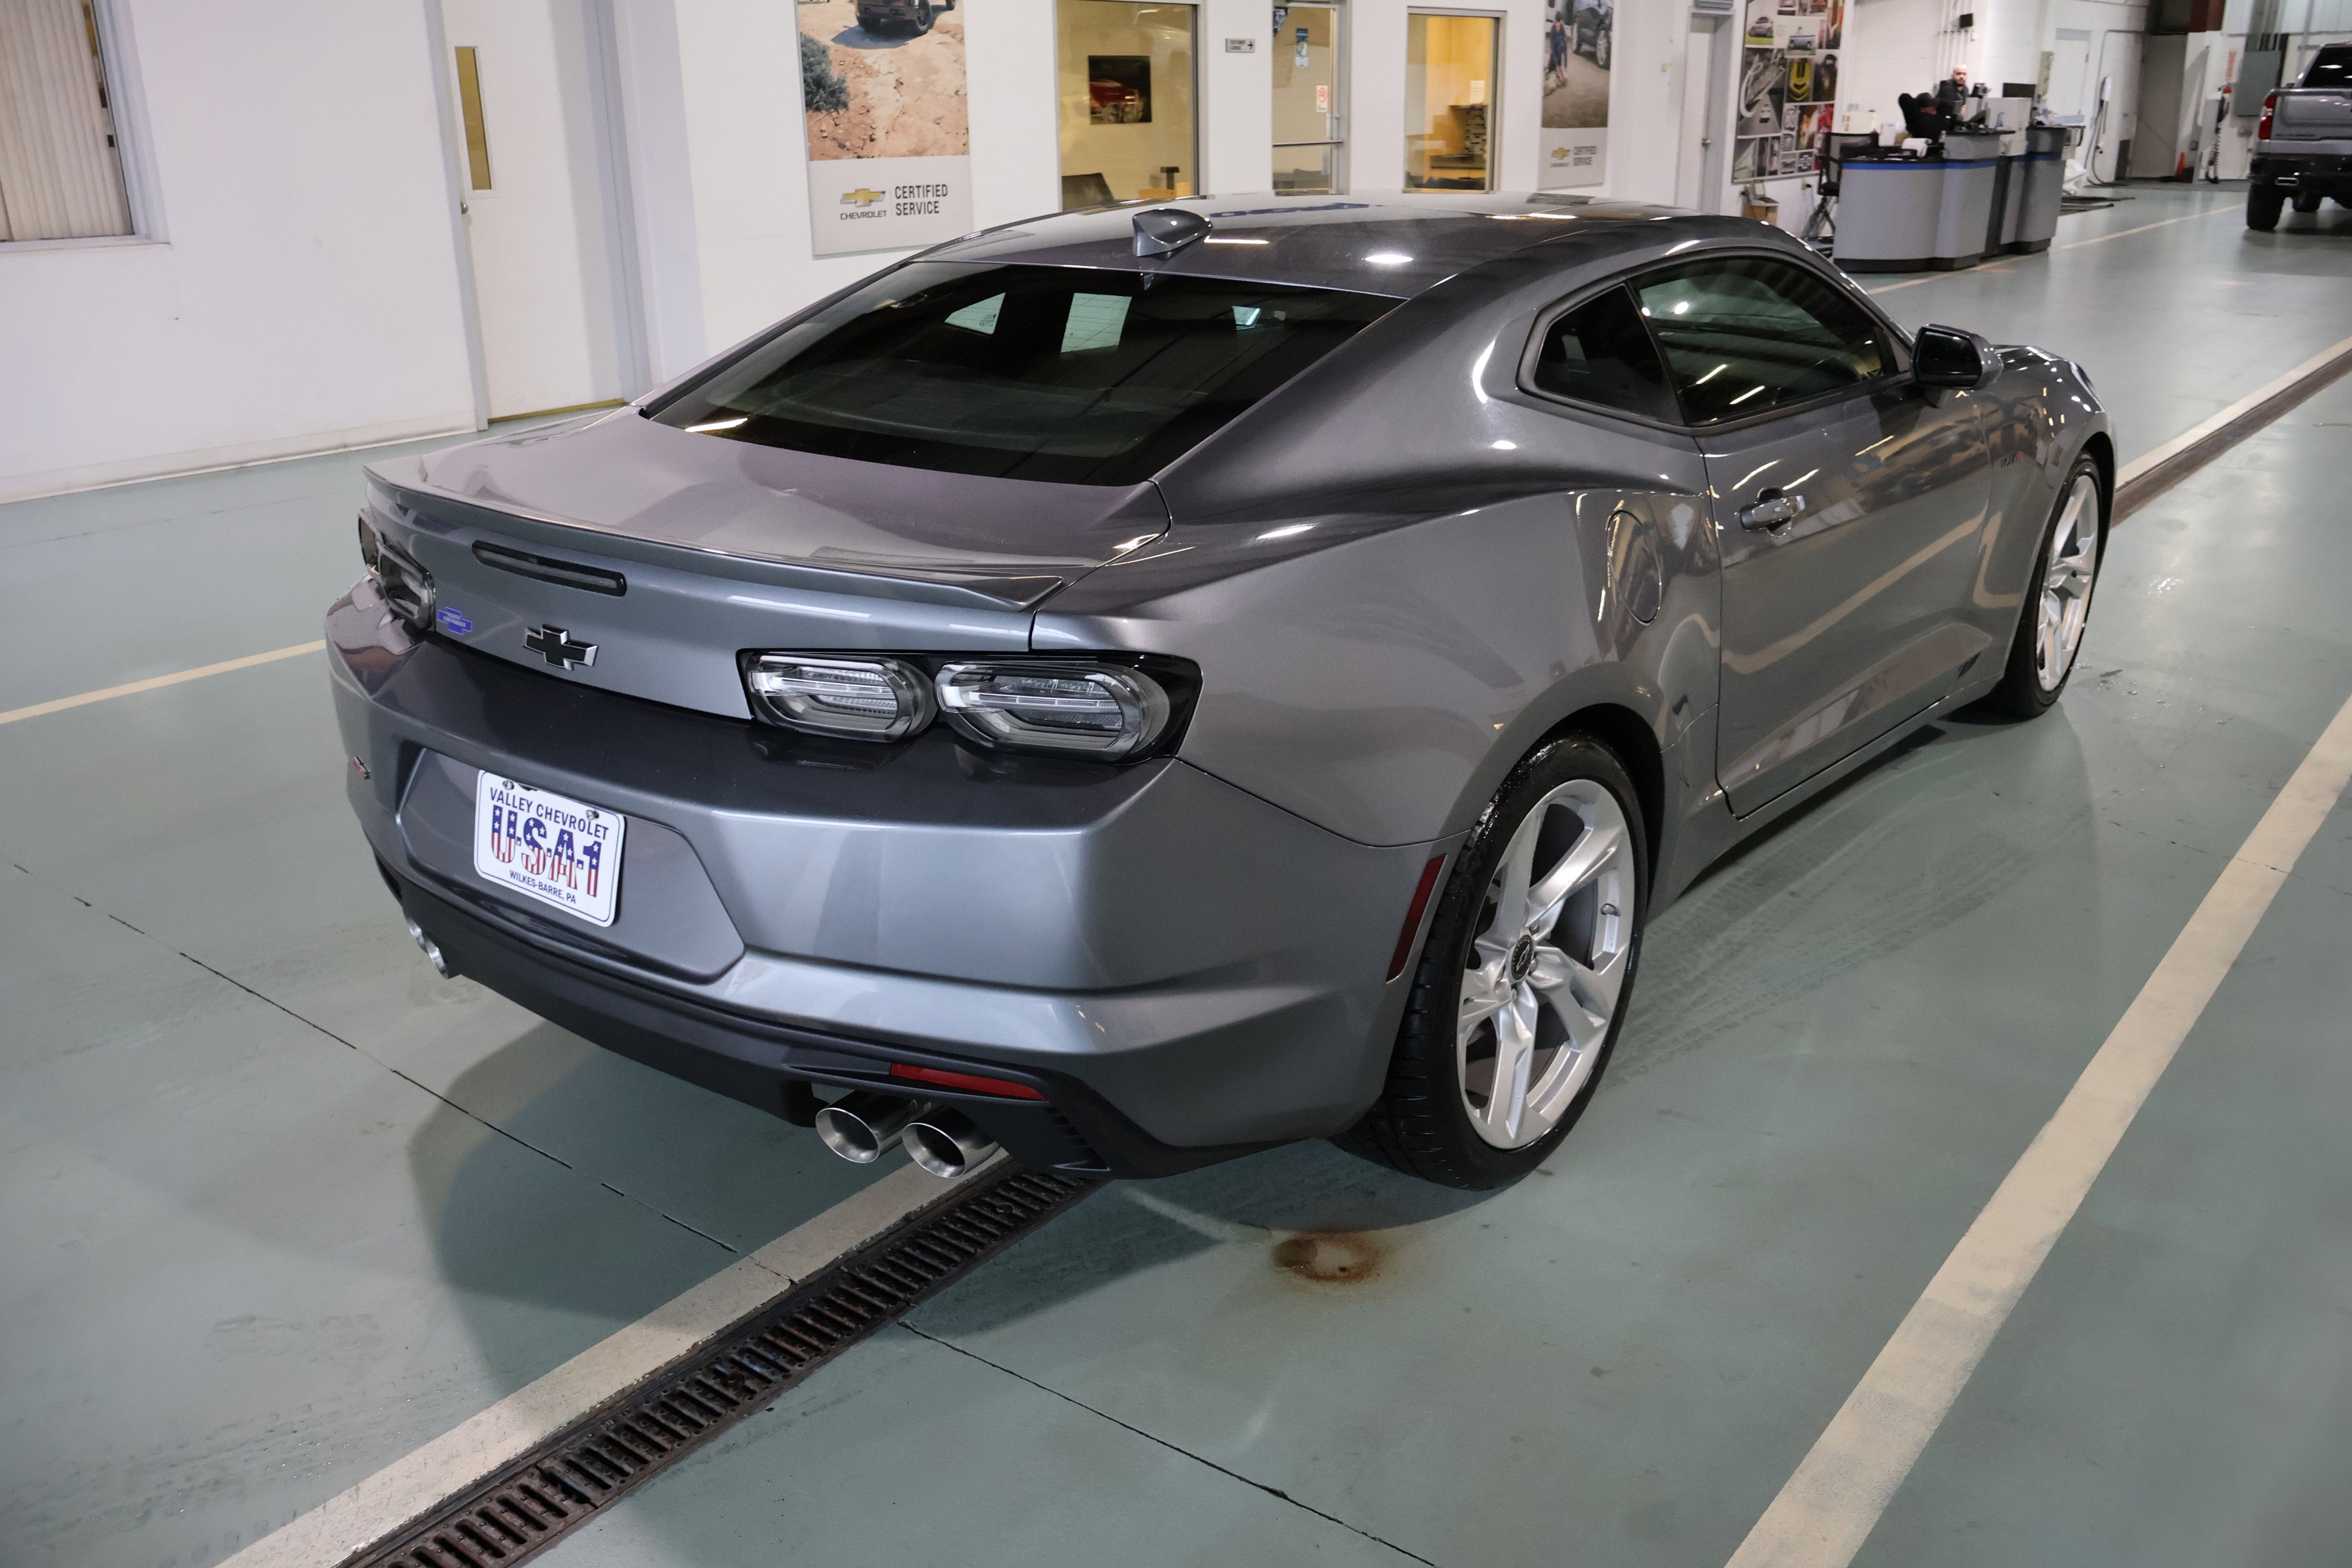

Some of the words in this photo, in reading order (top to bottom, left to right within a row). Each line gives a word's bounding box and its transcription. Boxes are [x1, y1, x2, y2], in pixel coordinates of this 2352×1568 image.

[895, 184, 948, 199] CERTIFIED
[840, 210, 887, 220] CHEVROLET
[895, 201, 940, 216] SERVICE
[490, 787, 533, 813] VALLEY
[537, 804, 609, 840] CHEVROLET
[510, 870, 564, 901] WILKES-BARRE,
[566, 893, 576, 904] PA
